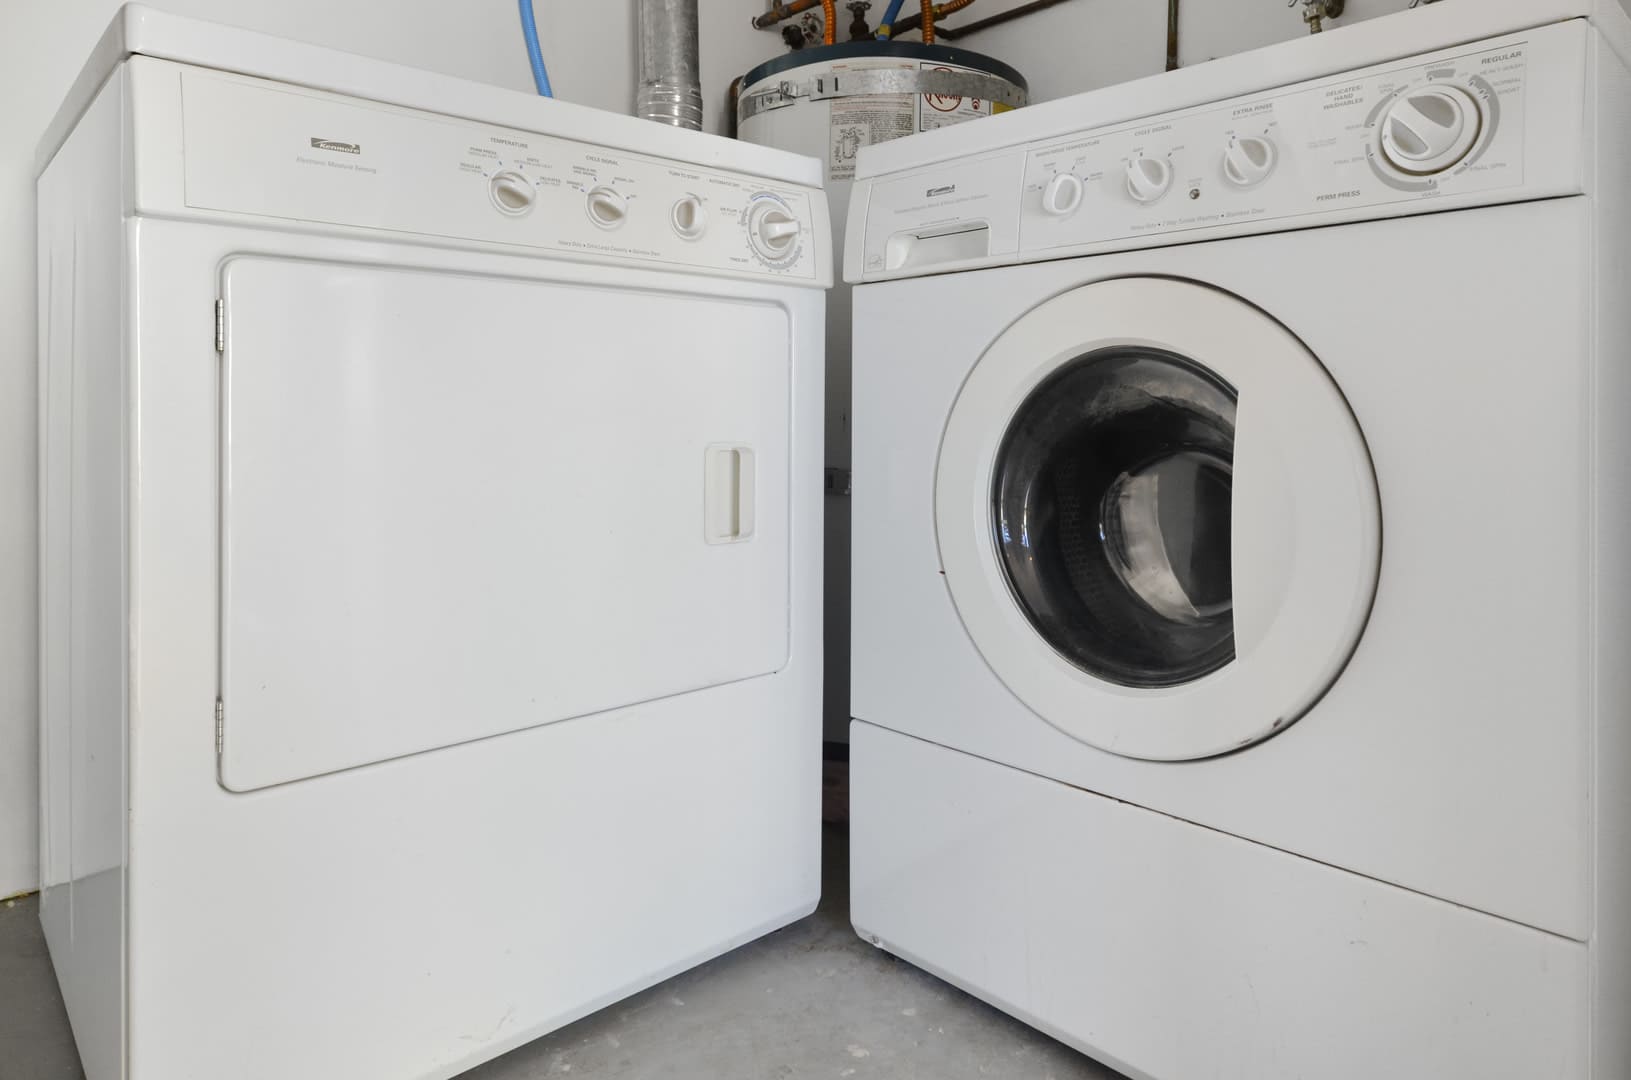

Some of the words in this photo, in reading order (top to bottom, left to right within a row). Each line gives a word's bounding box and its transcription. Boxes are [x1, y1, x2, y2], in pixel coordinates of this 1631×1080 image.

[1481, 51, 1522, 65] REGULAR
[1334, 93, 1354, 102] HAND
[1233, 107, 1253, 117] EXTRA
[317, 141, 361, 154] Kenmore
[490, 137, 529, 149] TEMPERATURE
[1316, 193, 1337, 202] PERM
[1338, 190, 1361, 199] PRESS
